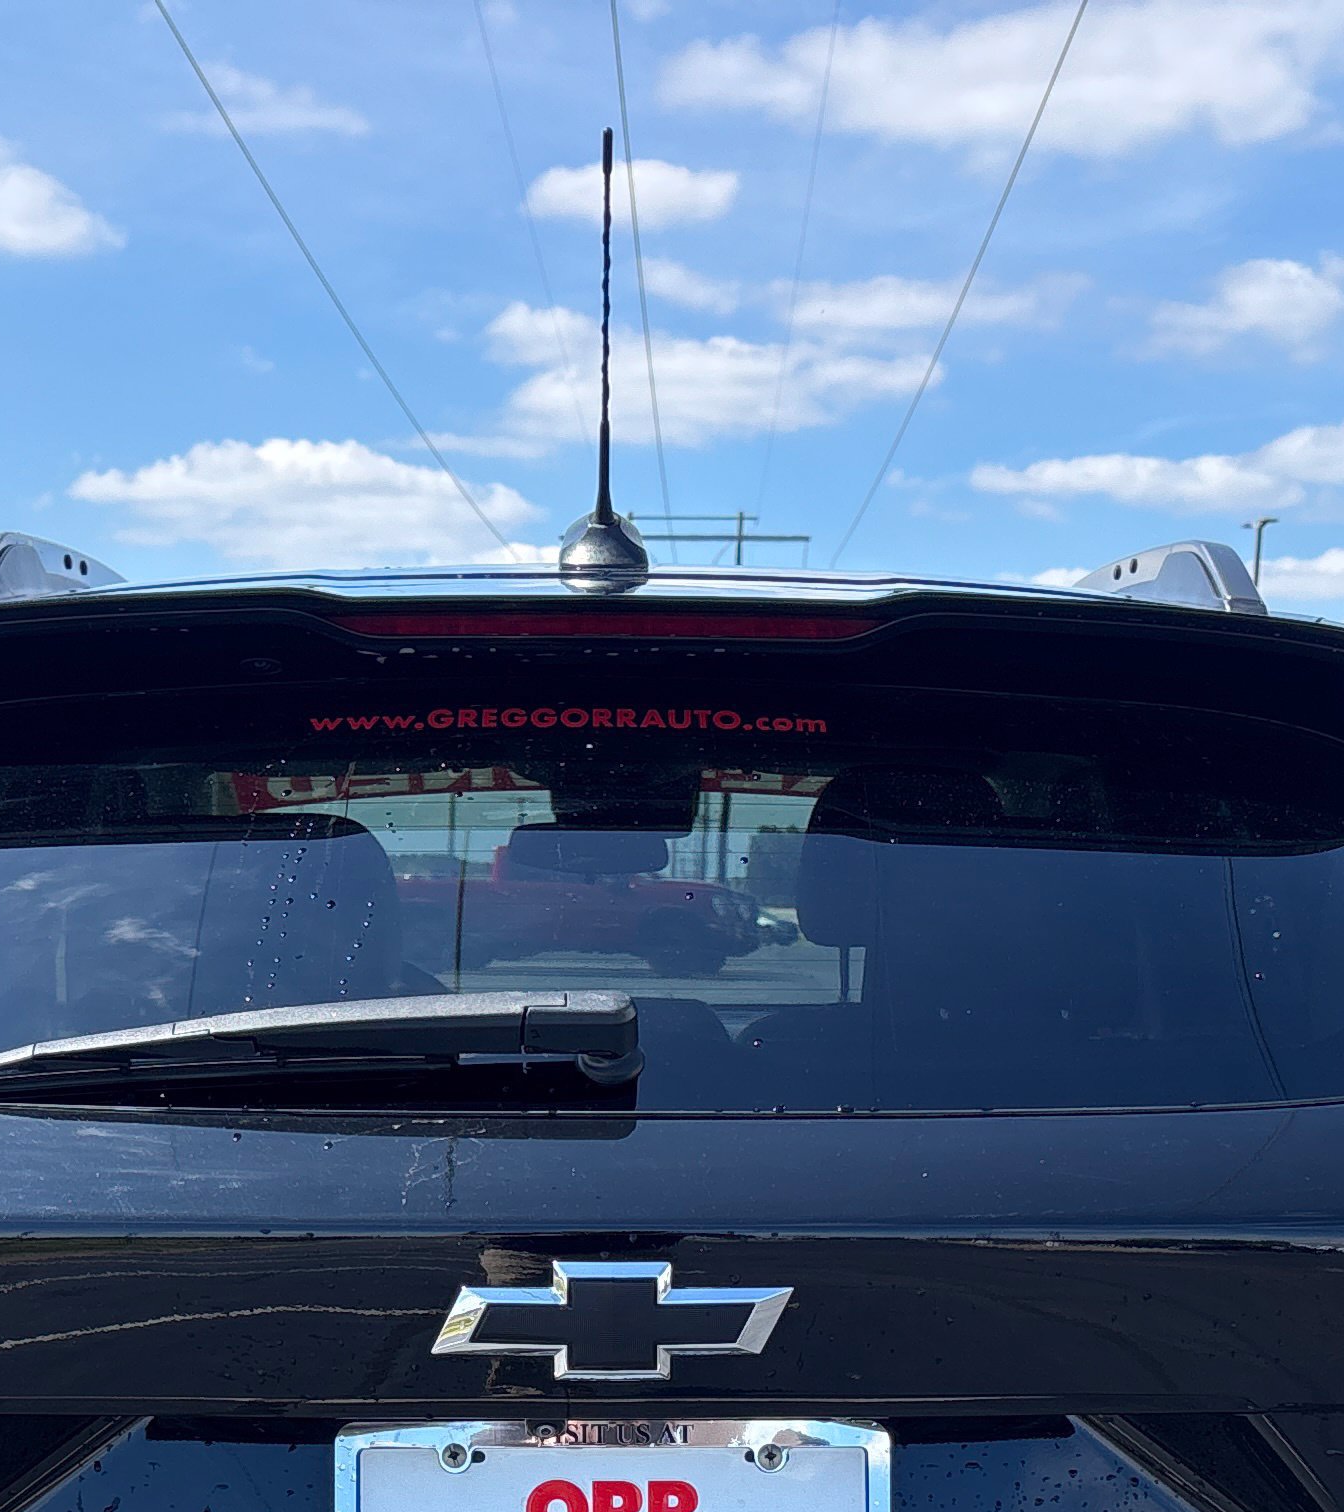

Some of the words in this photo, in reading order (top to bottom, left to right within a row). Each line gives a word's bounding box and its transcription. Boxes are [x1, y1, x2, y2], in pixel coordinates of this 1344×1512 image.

[309, 707, 827, 733] www.GREGGORRAUTO.com
[616, 1423, 651, 1446] US
[657, 1423, 695, 1445] AT
